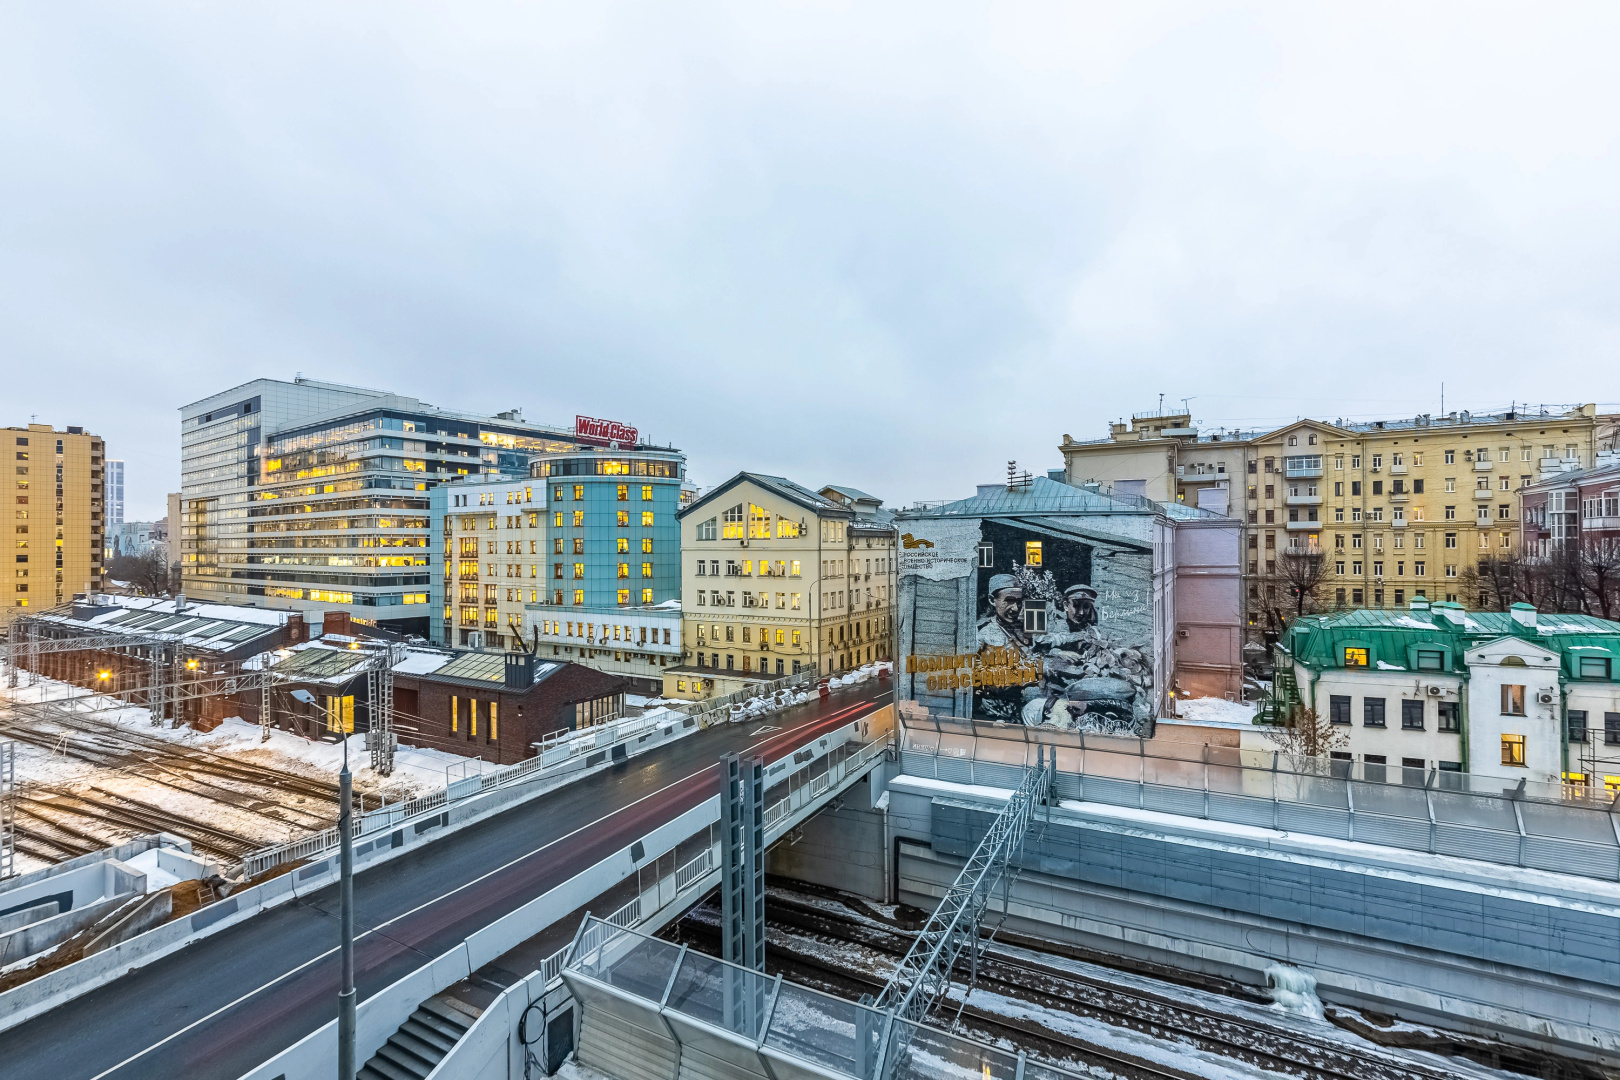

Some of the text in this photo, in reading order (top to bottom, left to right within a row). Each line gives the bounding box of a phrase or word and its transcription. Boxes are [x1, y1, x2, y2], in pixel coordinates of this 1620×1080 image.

[578, 418, 636, 441] World Class
[906, 654, 973, 673] Помнит
